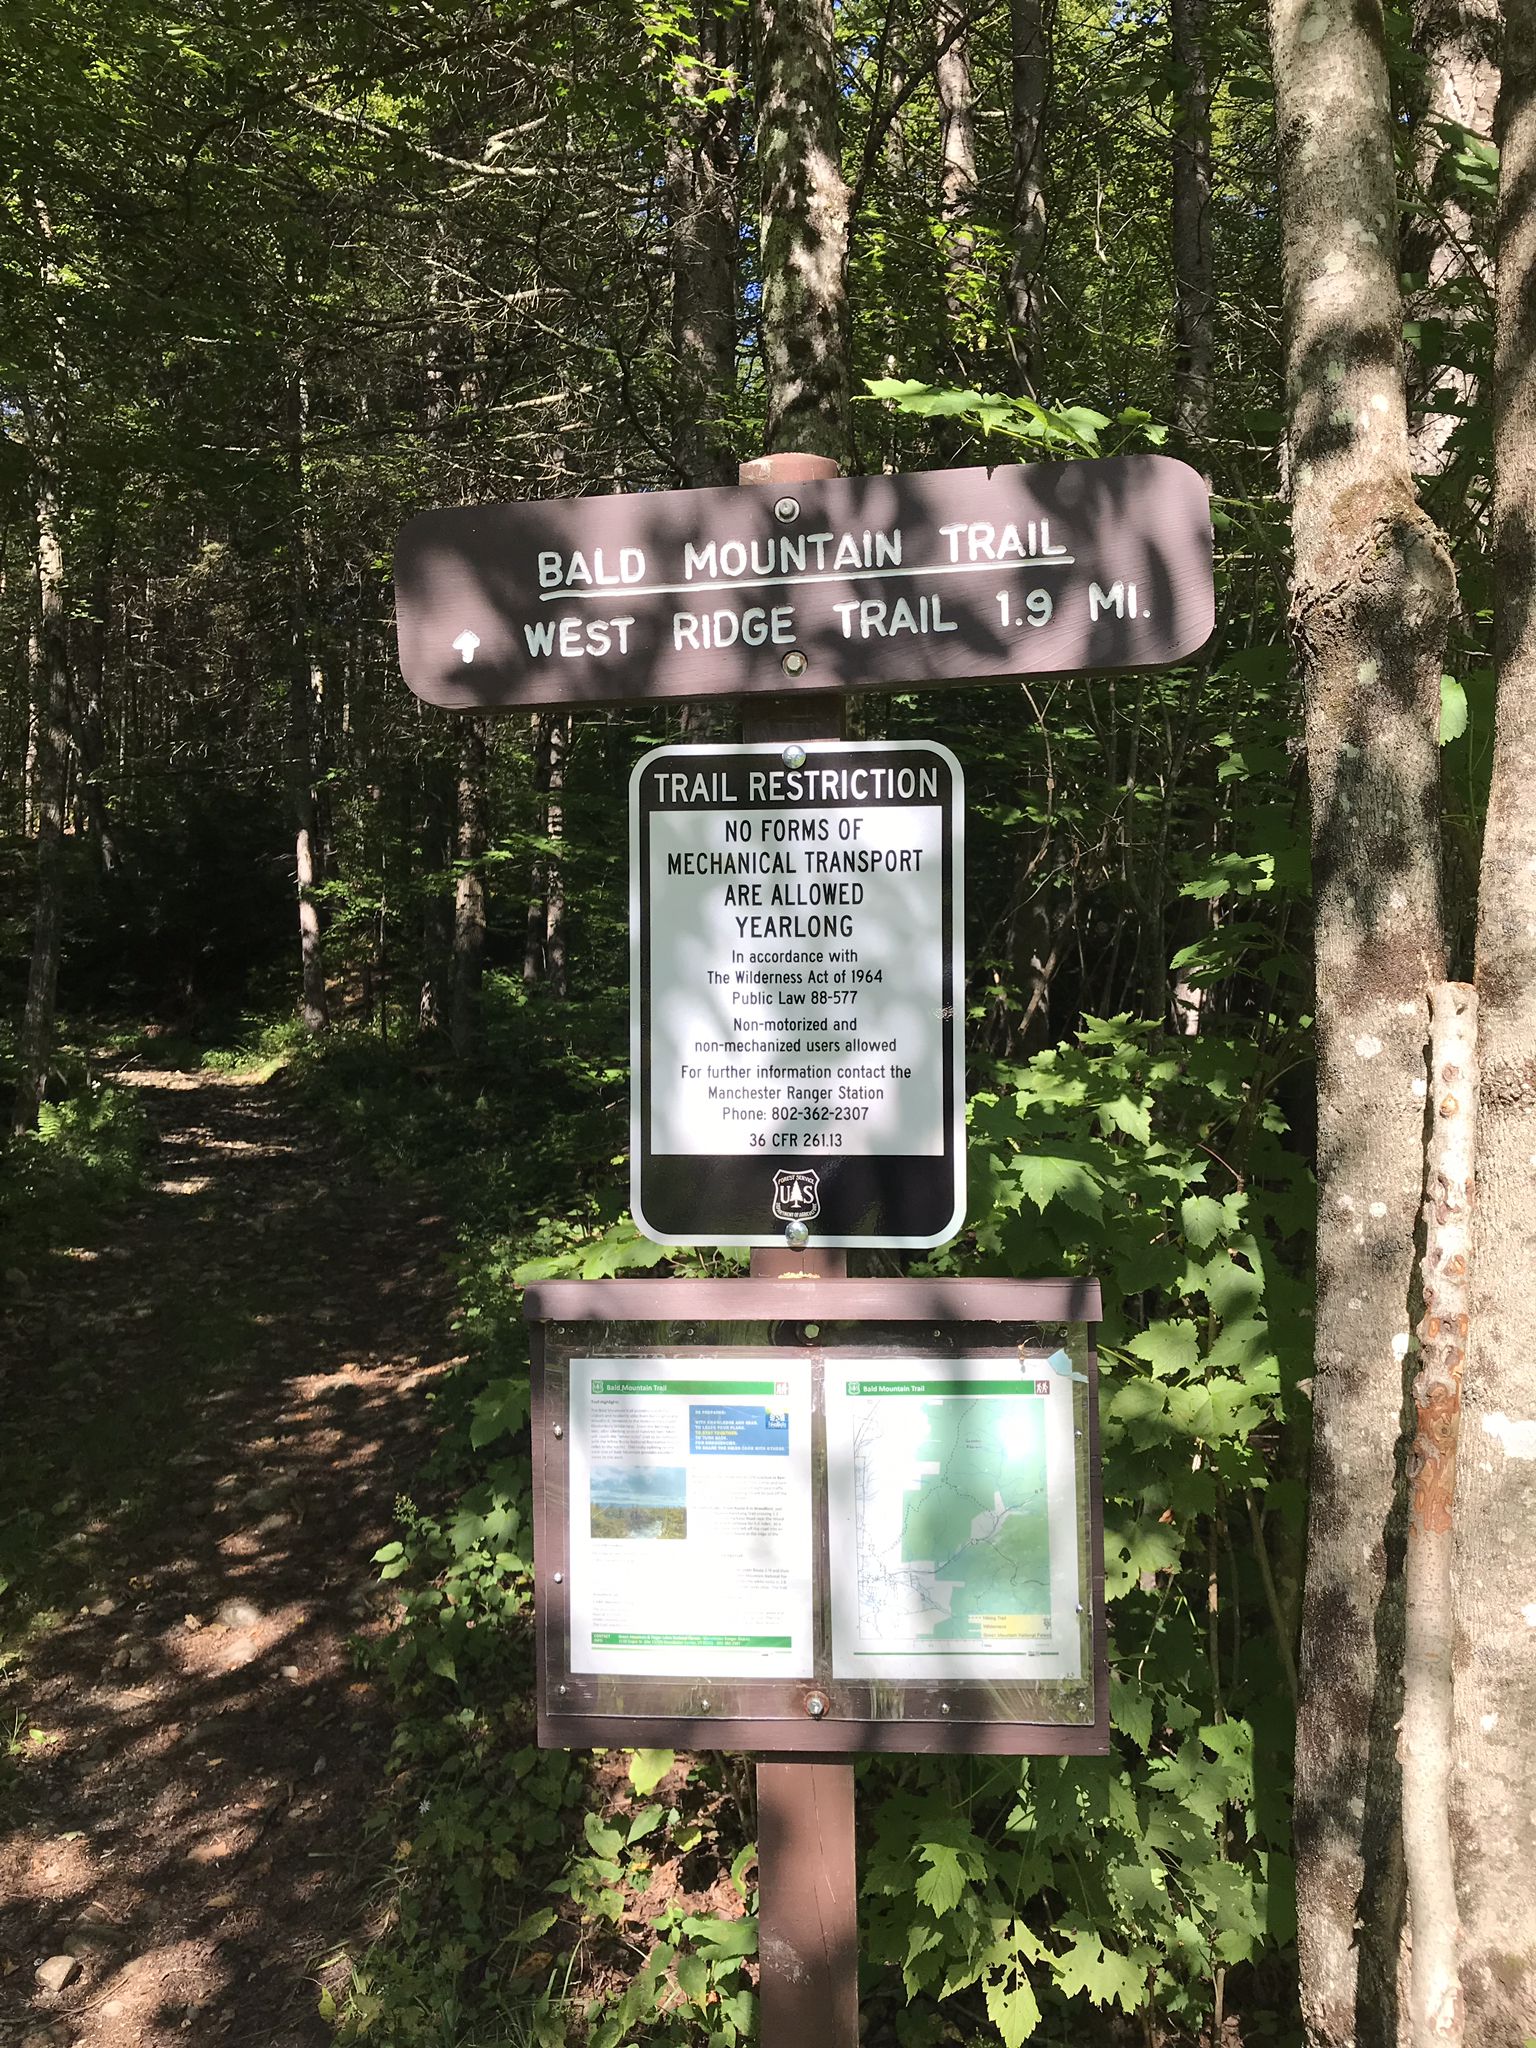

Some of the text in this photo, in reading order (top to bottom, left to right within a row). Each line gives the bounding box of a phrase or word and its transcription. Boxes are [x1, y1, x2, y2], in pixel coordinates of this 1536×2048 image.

[537, 517, 1068, 589] BALD MOUNTAIN TRAIL
[523, 579, 1152, 659] WEST RIDGE TRAIL 1.9 MI.
[653, 767, 938, 803] TRAIL RESTRICTION
[726, 818, 863, 842] NO FORMS OF
[668, 849, 923, 875] MECHANICAL TRANSPORT
[725, 883, 863, 906] ARE ALLOWED
[736, 915, 852, 938] YEARLONG
[733, 949, 857, 963] In accordance with
[707, 968, 883, 984] The Wilderness Act of 1964
[733, 991, 858, 1004] Public Law 88-577
[734, 1017, 857, 1031] Non-motorized and
[695, 1037, 896, 1052] non-mechanized users allowed
[682, 1065, 911, 1079] For further information contact the
[709, 1086, 883, 1103] Manchester Ranger Station
[723, 1107, 869, 1120] Phone: 802-362-2307
[750, 1133, 842, 1147] 36 CFR 261.13
[778, 1175, 795, 1184] FOREST
